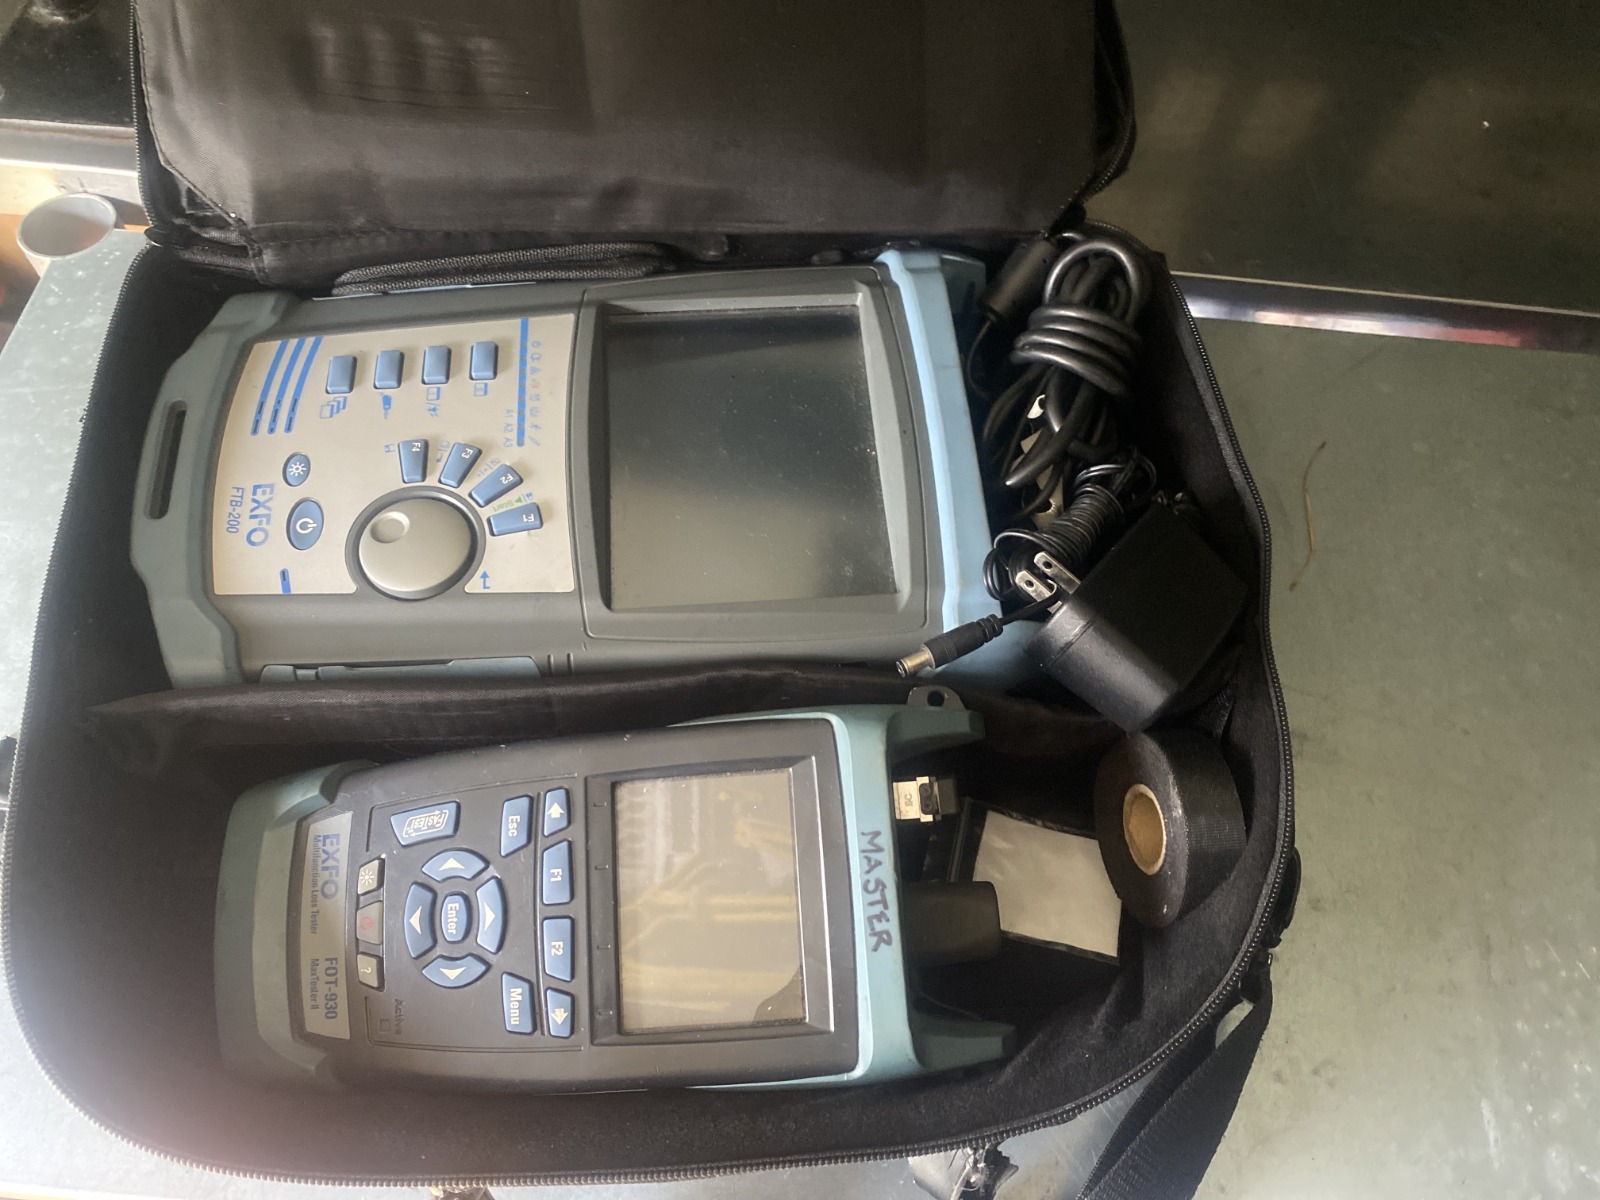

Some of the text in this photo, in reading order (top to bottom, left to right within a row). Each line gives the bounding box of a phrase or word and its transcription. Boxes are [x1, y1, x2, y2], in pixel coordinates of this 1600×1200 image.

[411, 442, 421, 453] F4
[461, 447, 474, 459] F3
[500, 473, 514, 484] F2
[226, 486, 245, 534] FTB-200
[246, 483, 275, 547] EXFO
[493, 500, 514, 513] Start
[522, 513, 535, 523] F1
[904, 793, 913, 807] SC
[508, 815, 521, 837] Esc
[320, 833, 341, 900] EXFO
[550, 868, 562, 882] F1
[310, 834, 322, 935] Multifunction Loss Tester
[860, 830, 893, 952] MASTER
[447, 903, 459, 934] Enter
[551, 941, 563, 956] F2
[310, 958, 320, 1002] MaxTester
[324, 957, 338, 1020] FOT-930
[509, 987, 522, 1025] Menu
